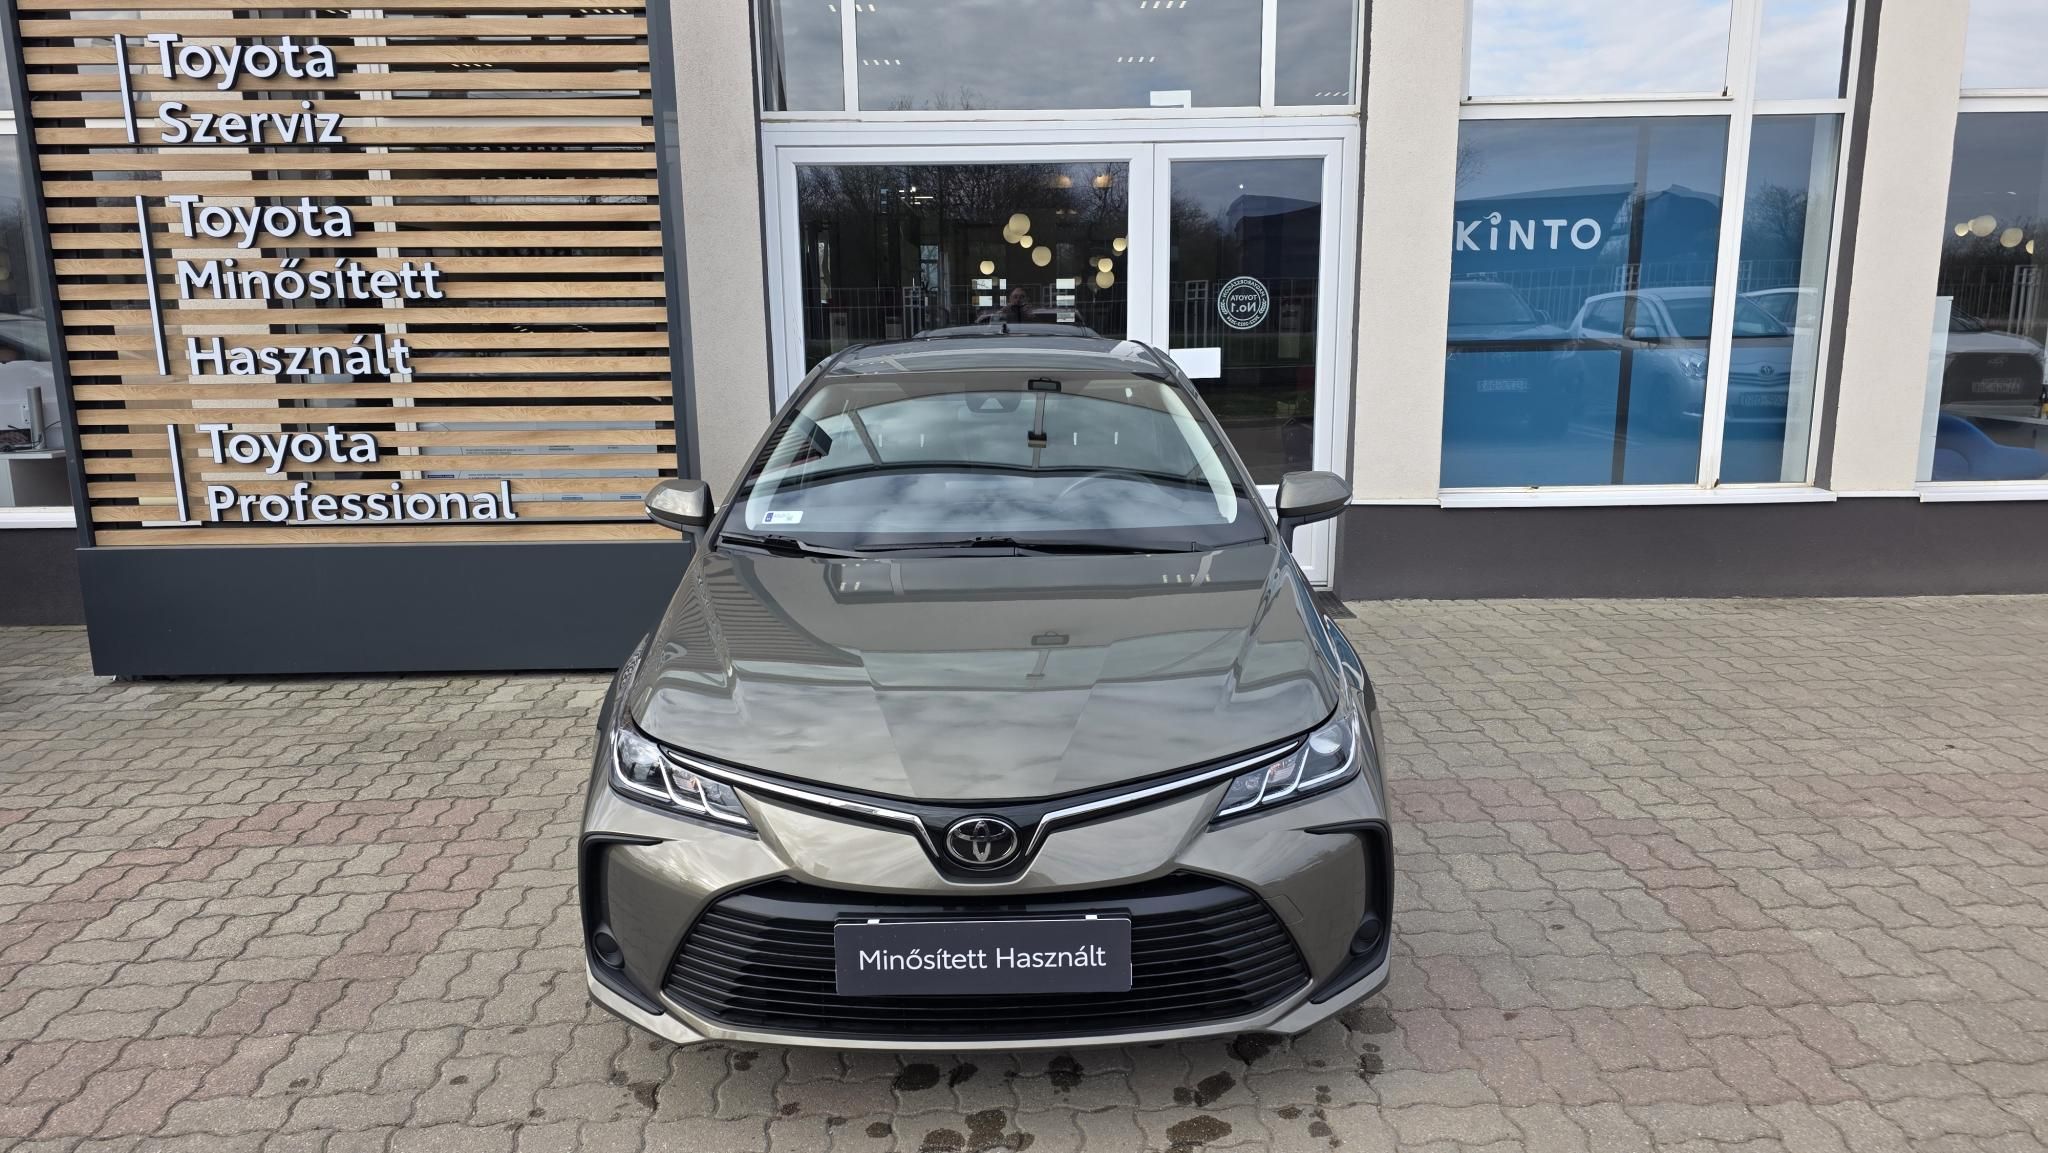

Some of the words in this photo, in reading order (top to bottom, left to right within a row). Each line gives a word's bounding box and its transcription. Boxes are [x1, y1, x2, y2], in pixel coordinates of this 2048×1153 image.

[148, 33, 336, 90] Toyota
[158, 101, 346, 144] Szerviz
[168, 194, 354, 249] Toyota
[176, 257, 445, 300] Minősített
[187, 333, 414, 376] Használt
[199, 424, 378, 474] Toyota
[206, 479, 517, 523] Professional
[858, 948, 988, 971] Minősített
[995, 944, 1107, 969] Használt
